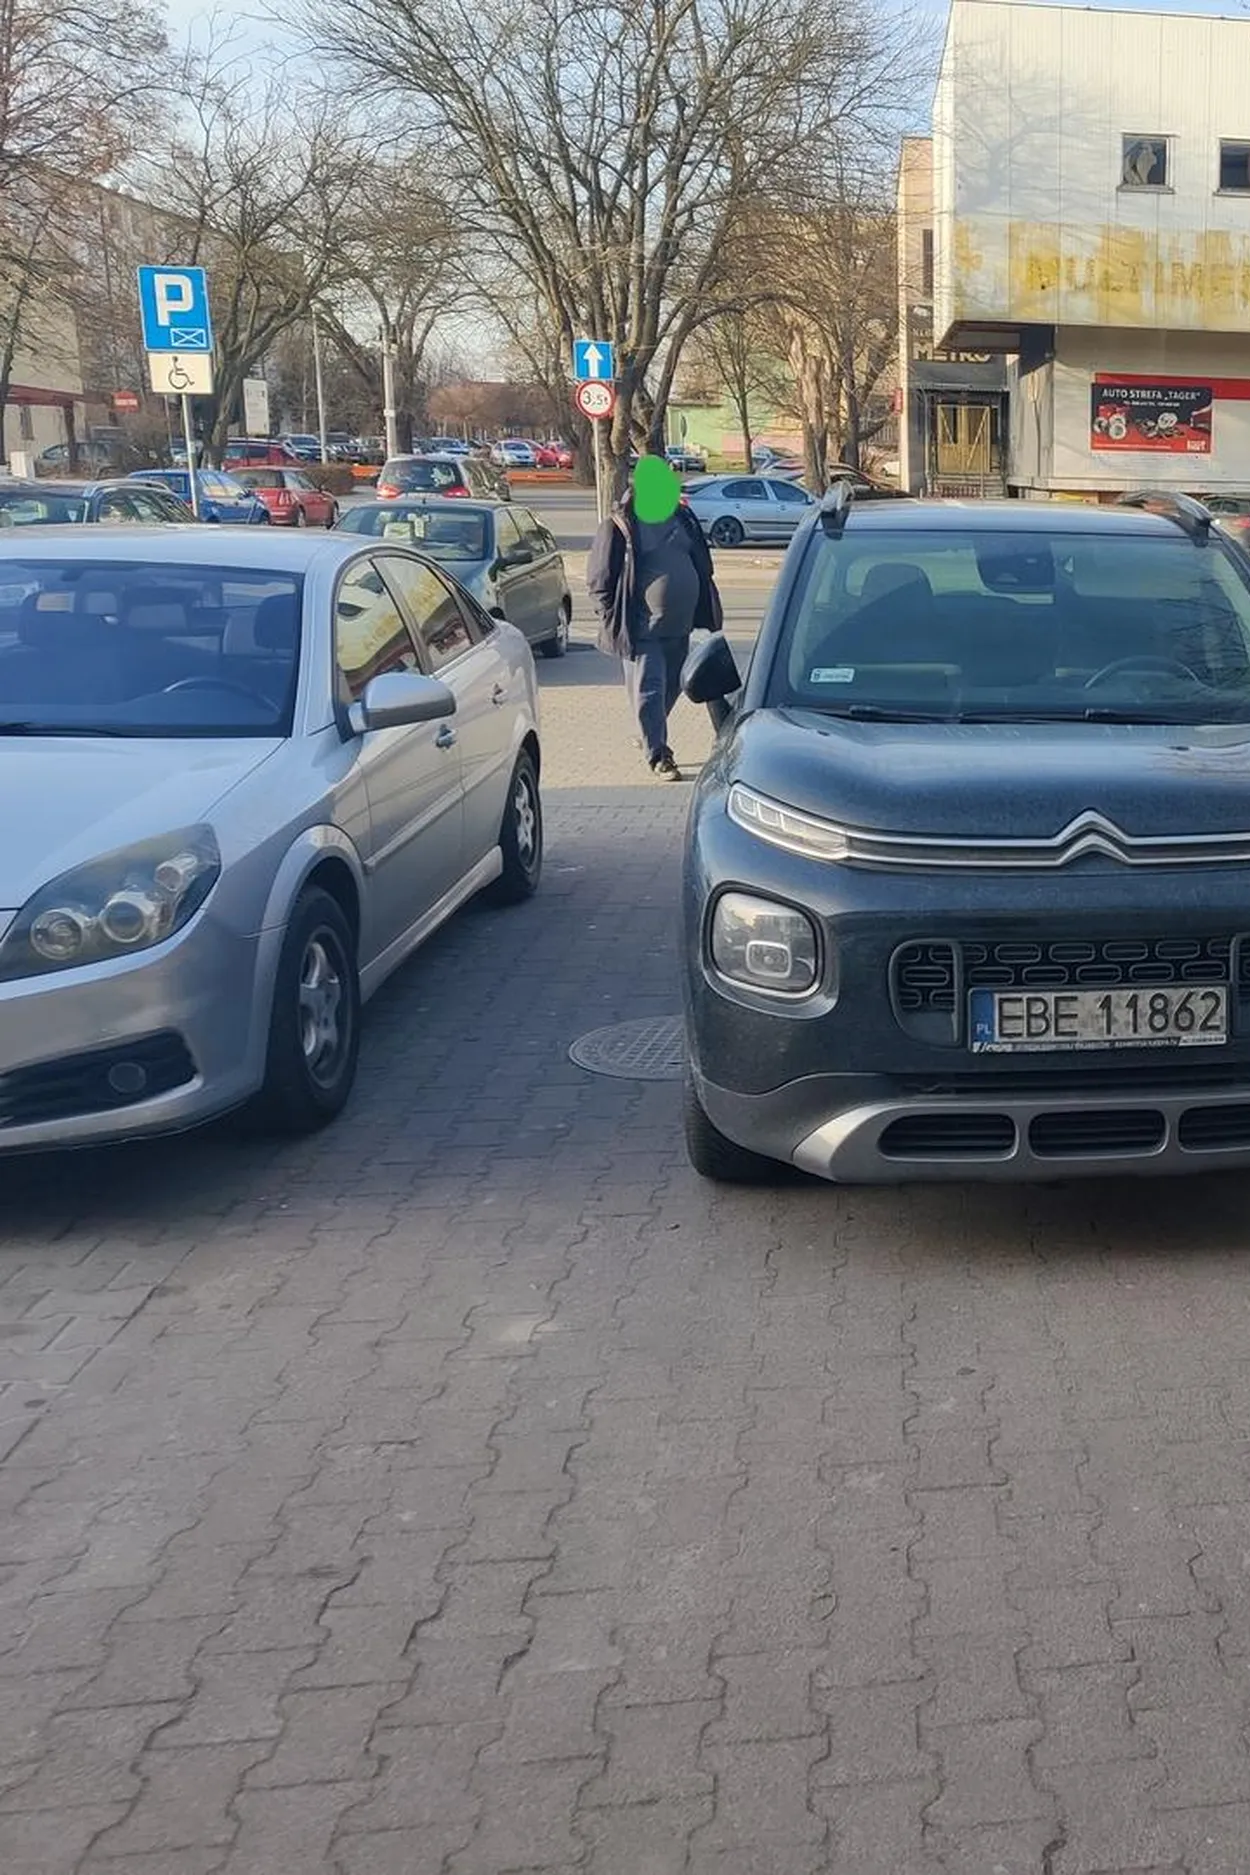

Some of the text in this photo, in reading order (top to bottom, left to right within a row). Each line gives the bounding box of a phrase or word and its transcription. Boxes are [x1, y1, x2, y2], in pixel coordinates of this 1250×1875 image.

[154, 273, 194, 326] P
[1102, 389, 1128, 399] AUTO
[1129, 389, 1162, 399] STREFA
[976, 1023, 992, 1034] PL
[998, 991, 1221, 1038] EBE 11862
